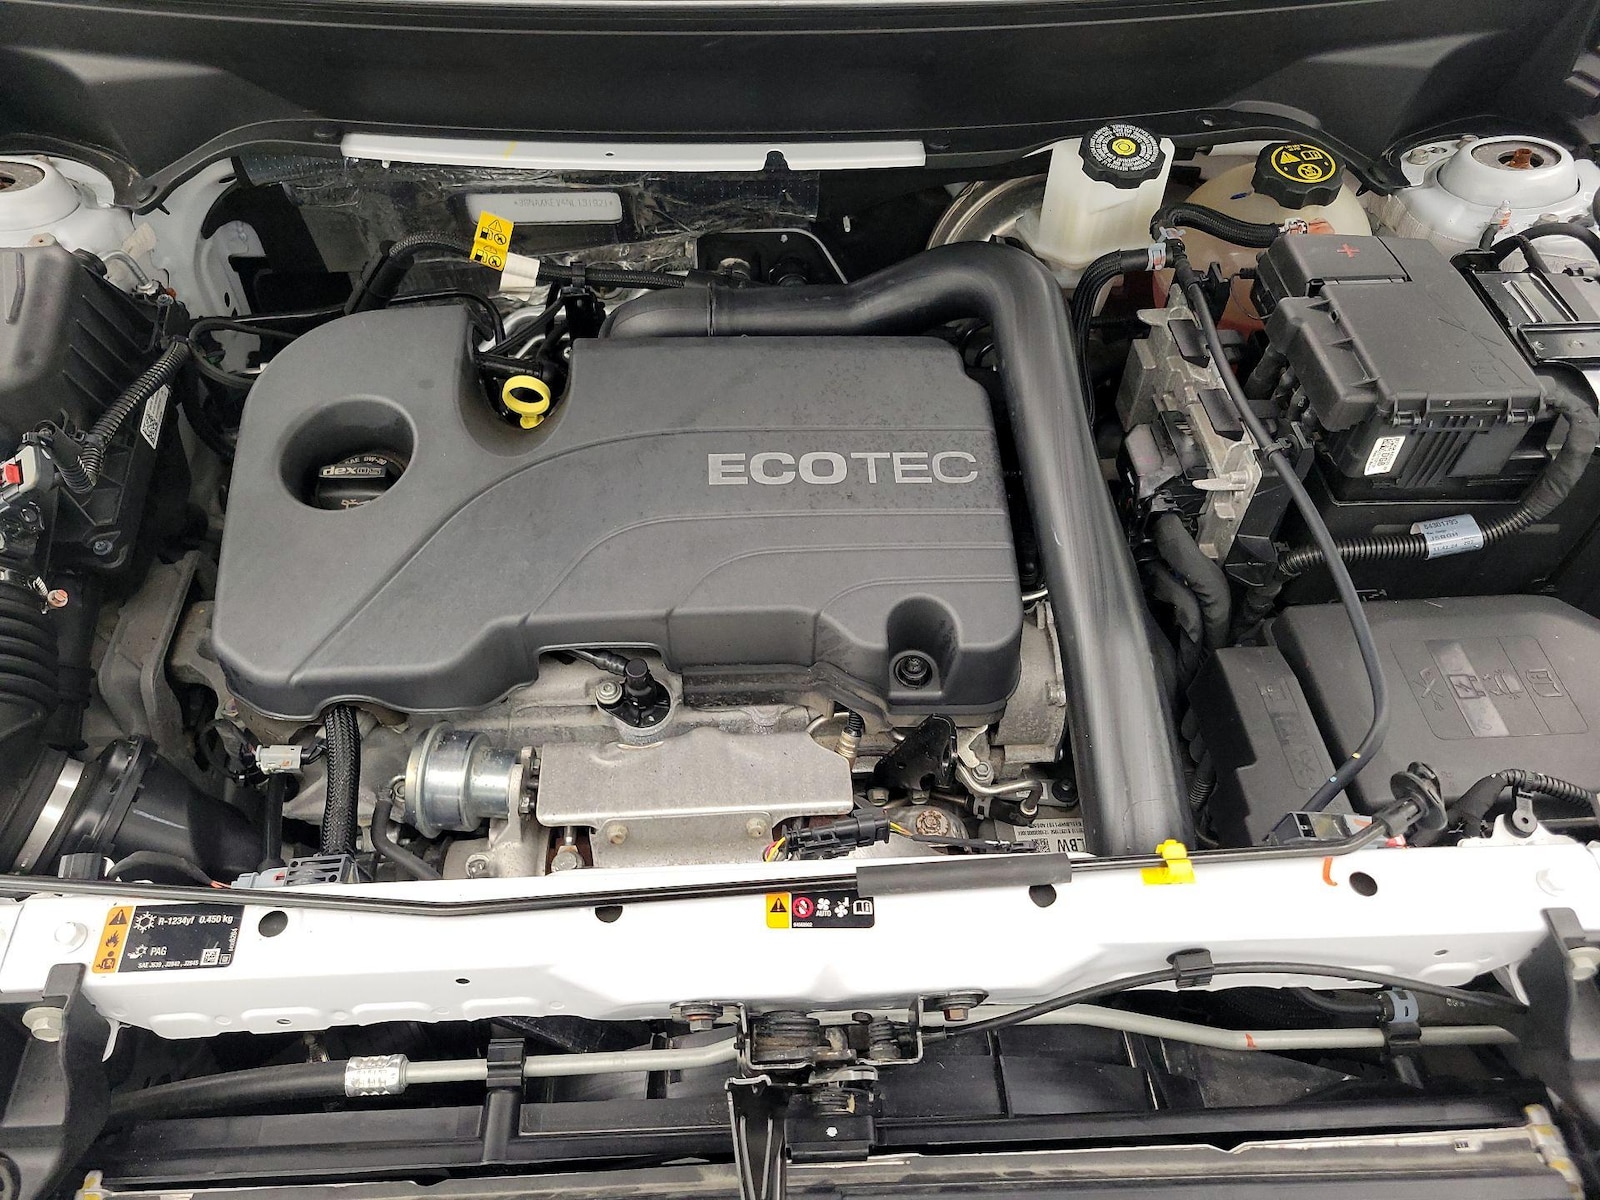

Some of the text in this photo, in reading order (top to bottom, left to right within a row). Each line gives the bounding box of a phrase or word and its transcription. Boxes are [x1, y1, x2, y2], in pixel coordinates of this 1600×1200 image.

[322, 466, 382, 476] dexos
[708, 451, 978, 485] ECOTEC
[158, 914, 234, 926] R-1234yf 0.450 kg
[150, 946, 168, 956] PAG
